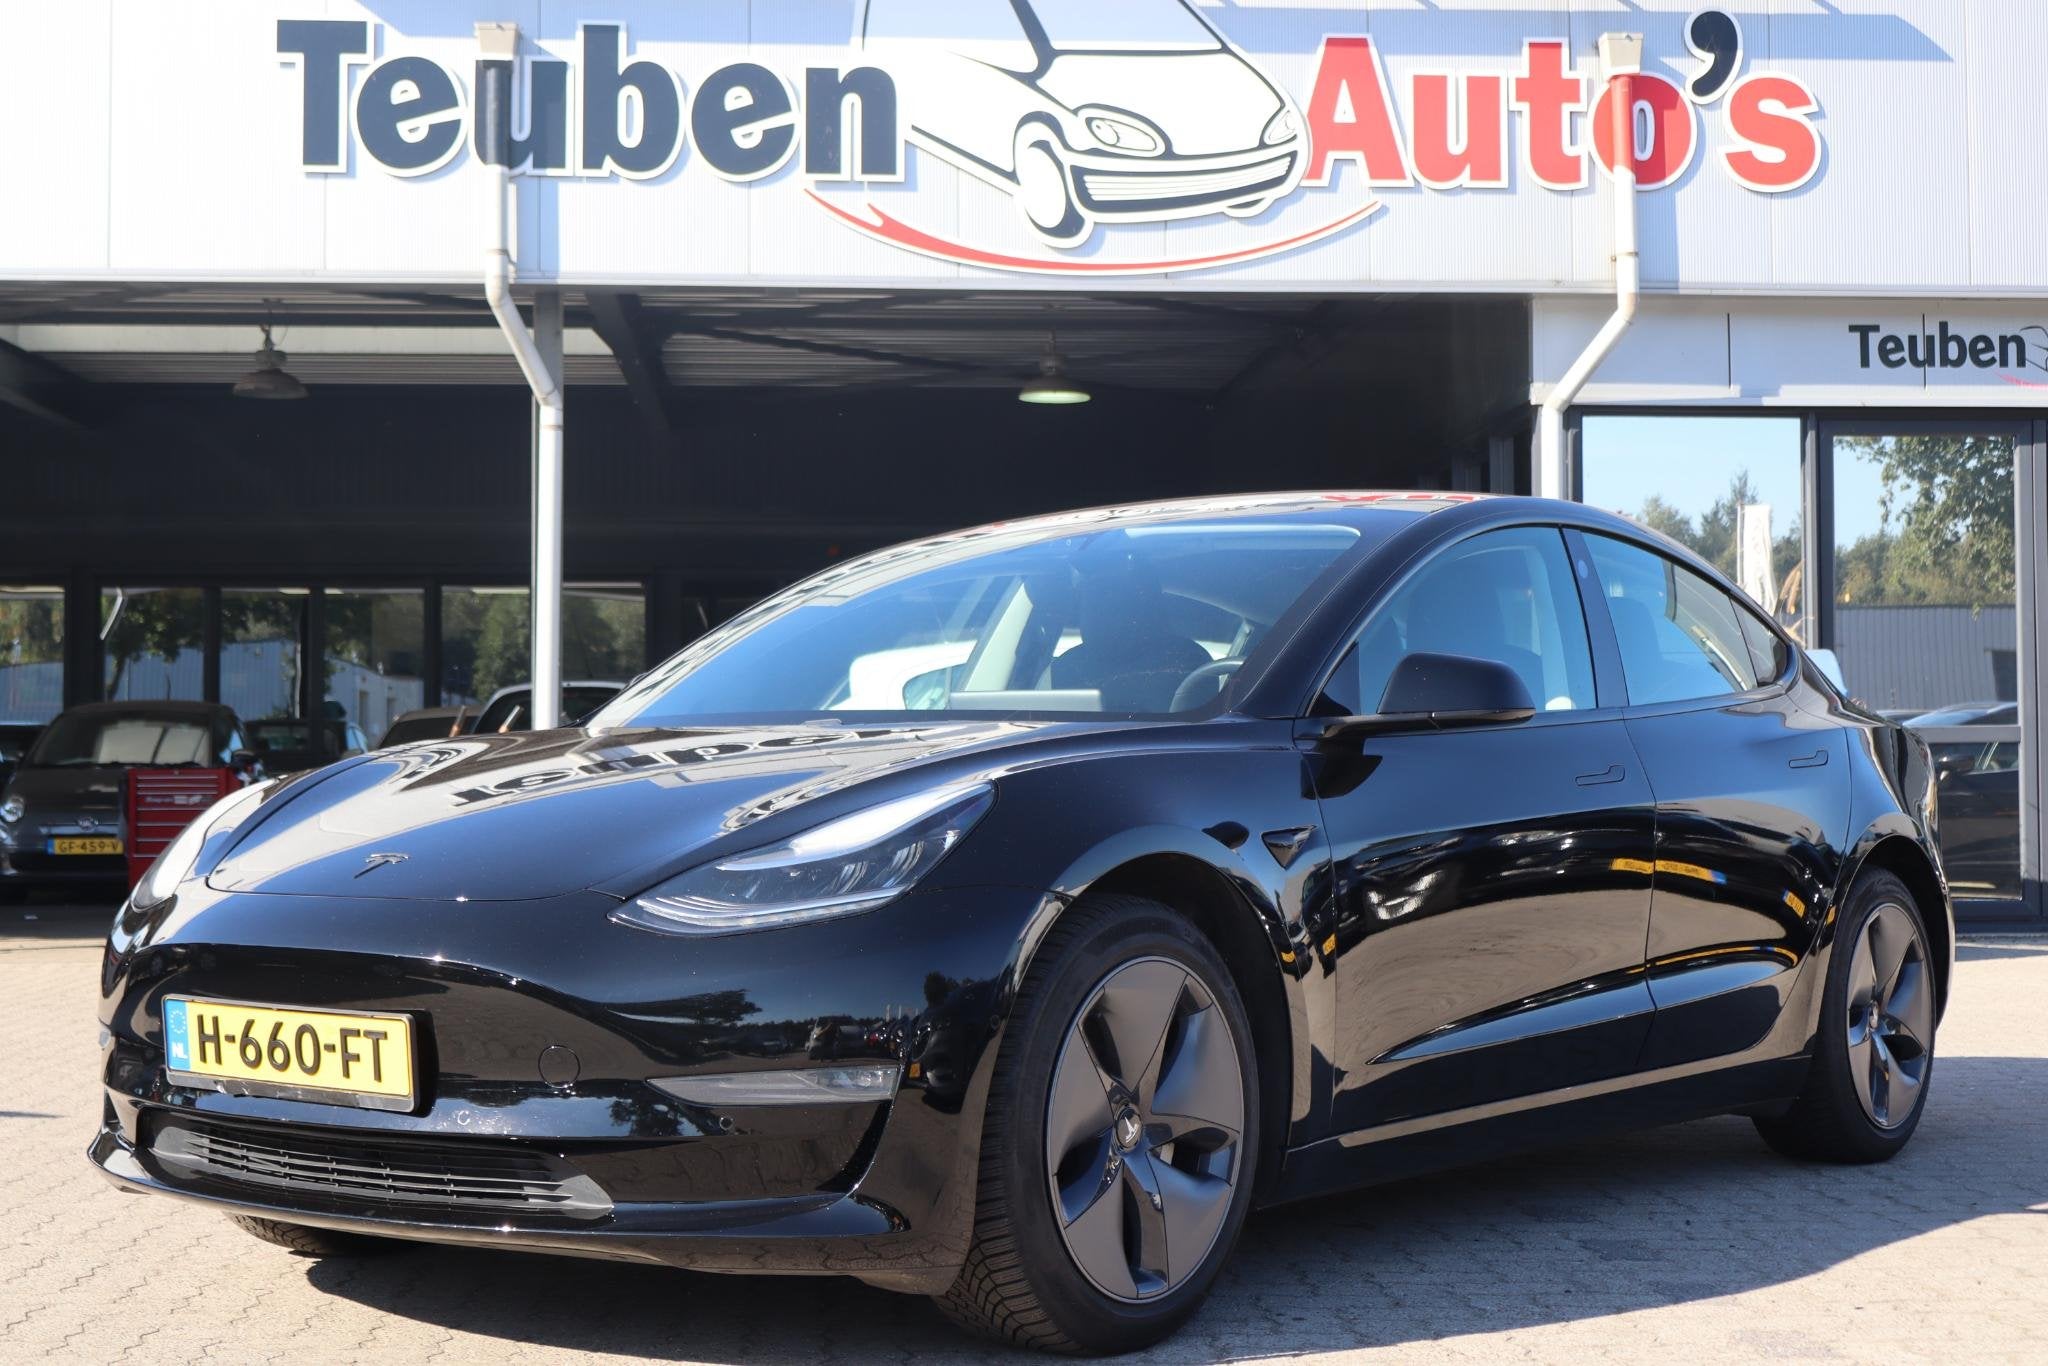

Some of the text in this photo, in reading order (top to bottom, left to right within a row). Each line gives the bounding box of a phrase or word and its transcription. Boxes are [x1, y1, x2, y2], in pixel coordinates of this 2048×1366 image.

[277, 11, 1818, 186] Teuben Auto's
[1848, 320, 2027, 369] Teuben
[172, 1042, 188, 1059] NL
[197, 1014, 388, 1083] H-660-FT
